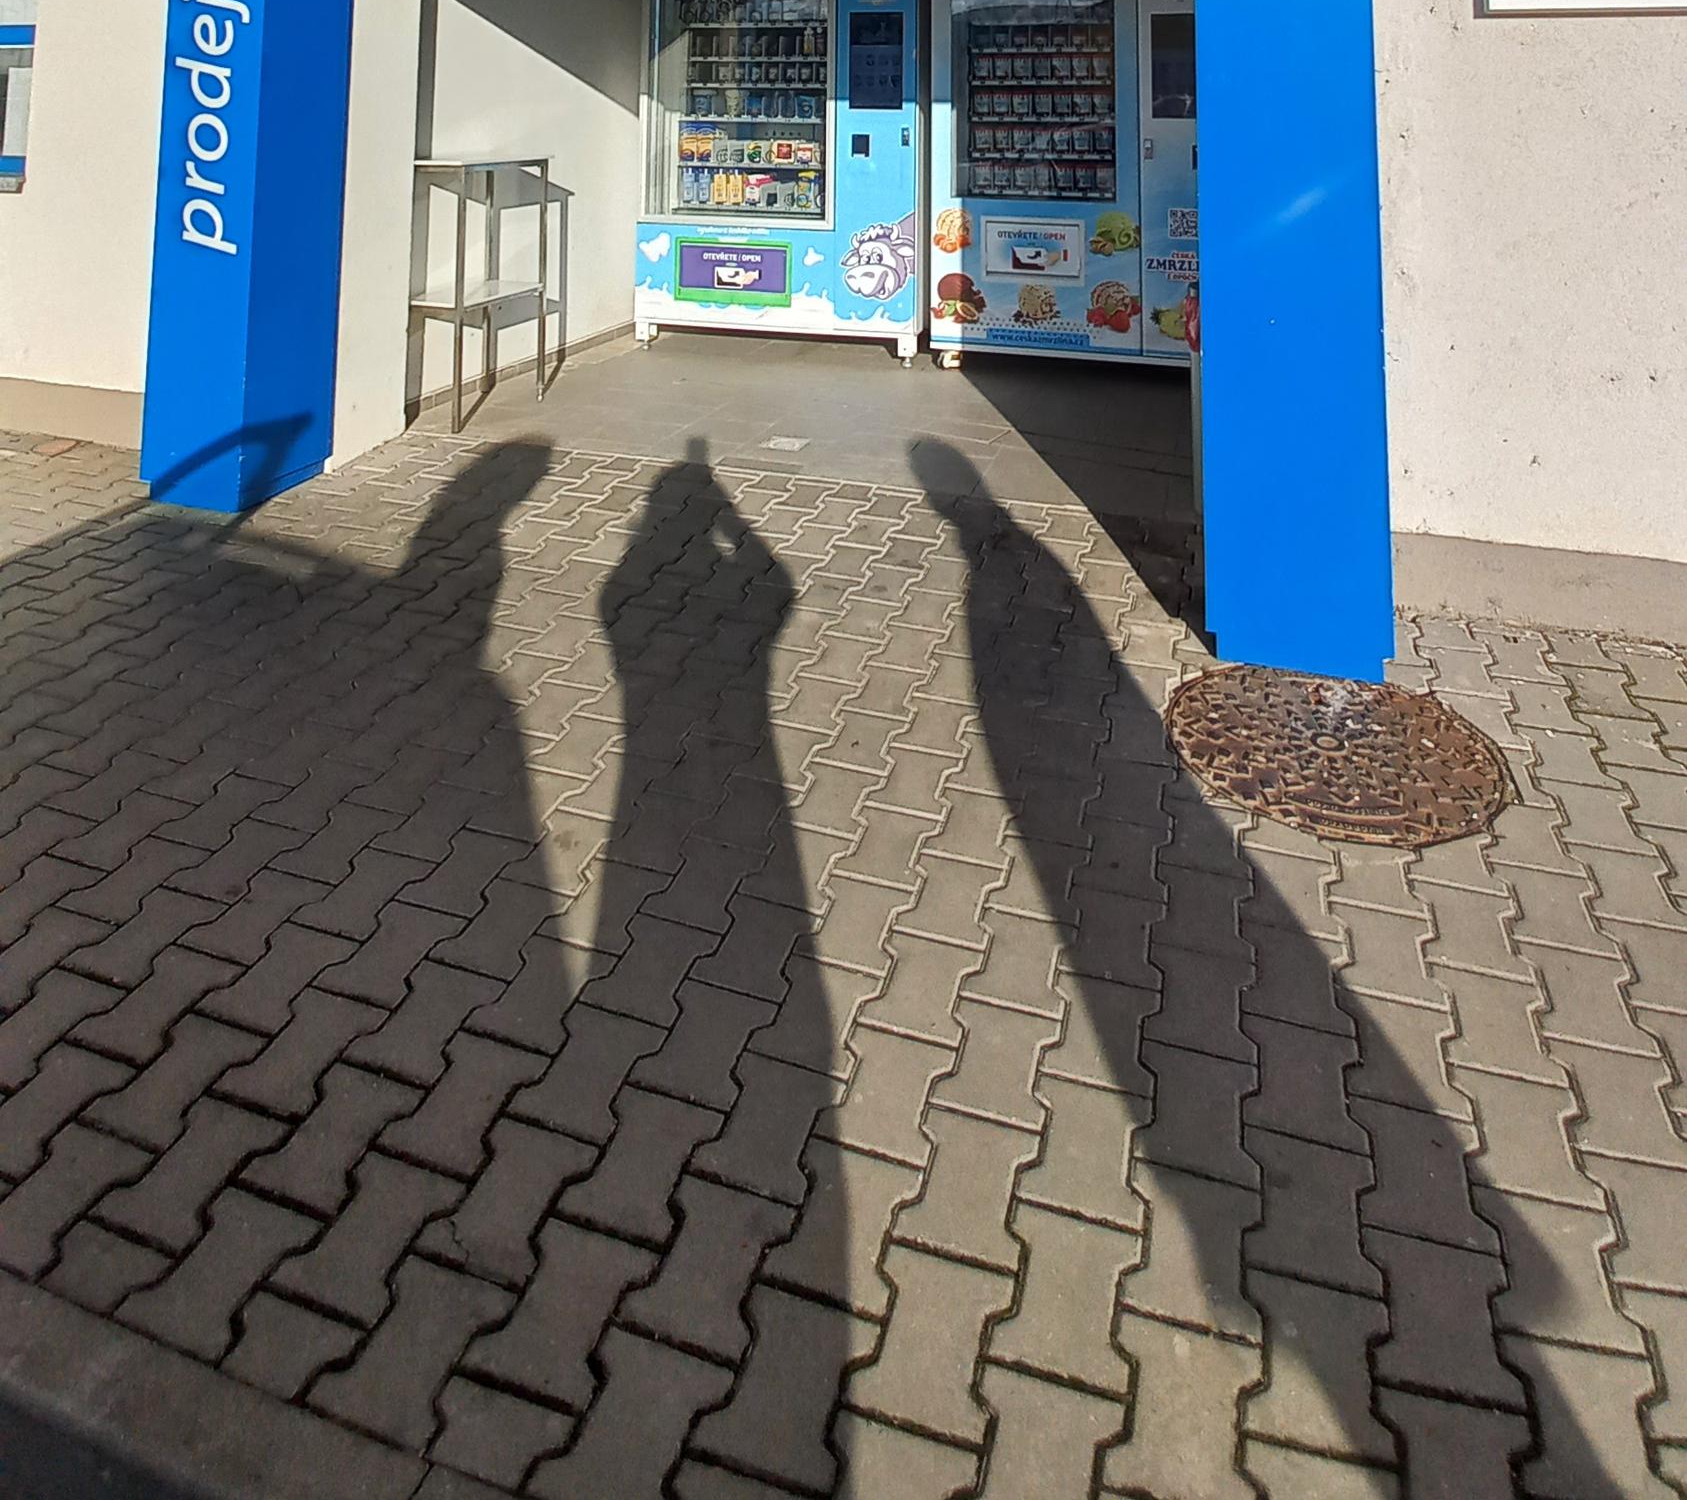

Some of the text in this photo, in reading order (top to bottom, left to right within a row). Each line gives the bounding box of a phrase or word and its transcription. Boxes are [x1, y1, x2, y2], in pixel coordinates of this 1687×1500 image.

[997, 229, 1037, 240] OTEVŘETE
[1043, 231, 1066, 241] OPEN
[702, 252, 738, 262] OTEVŘETE
[741, 254, 761, 263] OPEN
